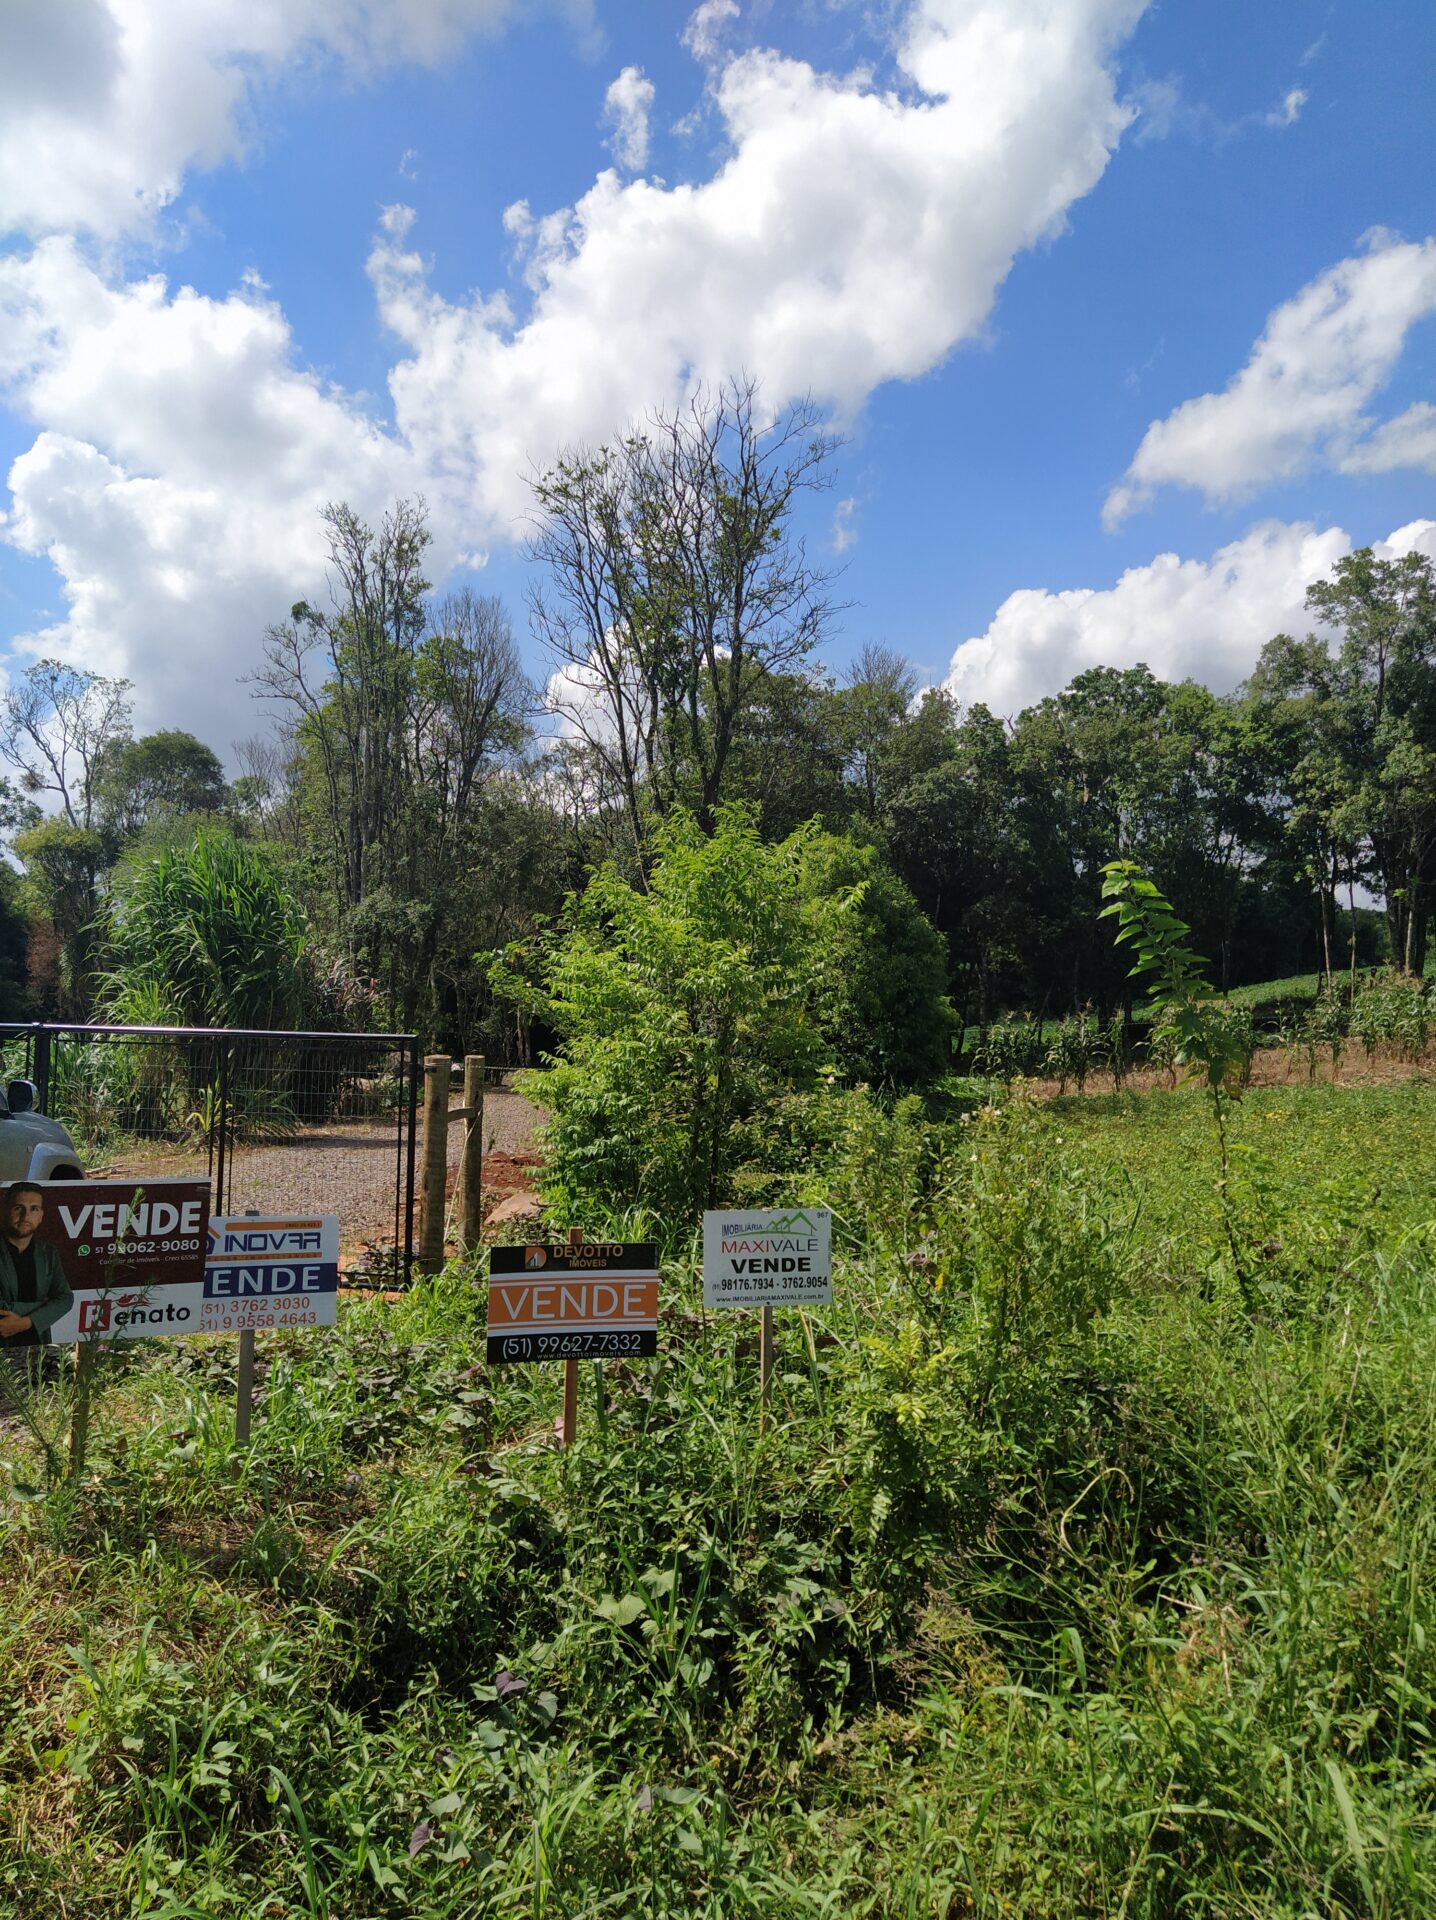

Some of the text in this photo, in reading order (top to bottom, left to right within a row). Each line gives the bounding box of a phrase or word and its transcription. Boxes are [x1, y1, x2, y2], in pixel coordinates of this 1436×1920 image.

[58, 1201, 202, 1239] VENDE
[816, 1211, 829, 1219] 967
[553, 1244, 624, 1259] DEVOTTO
[721, 1238, 819, 1253] MAXIVALE
[569, 1257, 607, 1268] IMÓVEIS
[731, 1257, 812, 1274] VENDE
[204, 1266, 321, 1295] ENDE
[721, 1278, 774, 1291] 98176.7934
[782, 1276, 828, 1289] 3762.9054
[230, 1299, 268, 1313] 3762
[273, 1296, 310, 1311] 3030
[501, 1284, 647, 1321] VENDE
[200, 1311, 317, 1331] 51) 9 9558 4643
[502, 1334, 641, 1359] (51) 99627-7332
